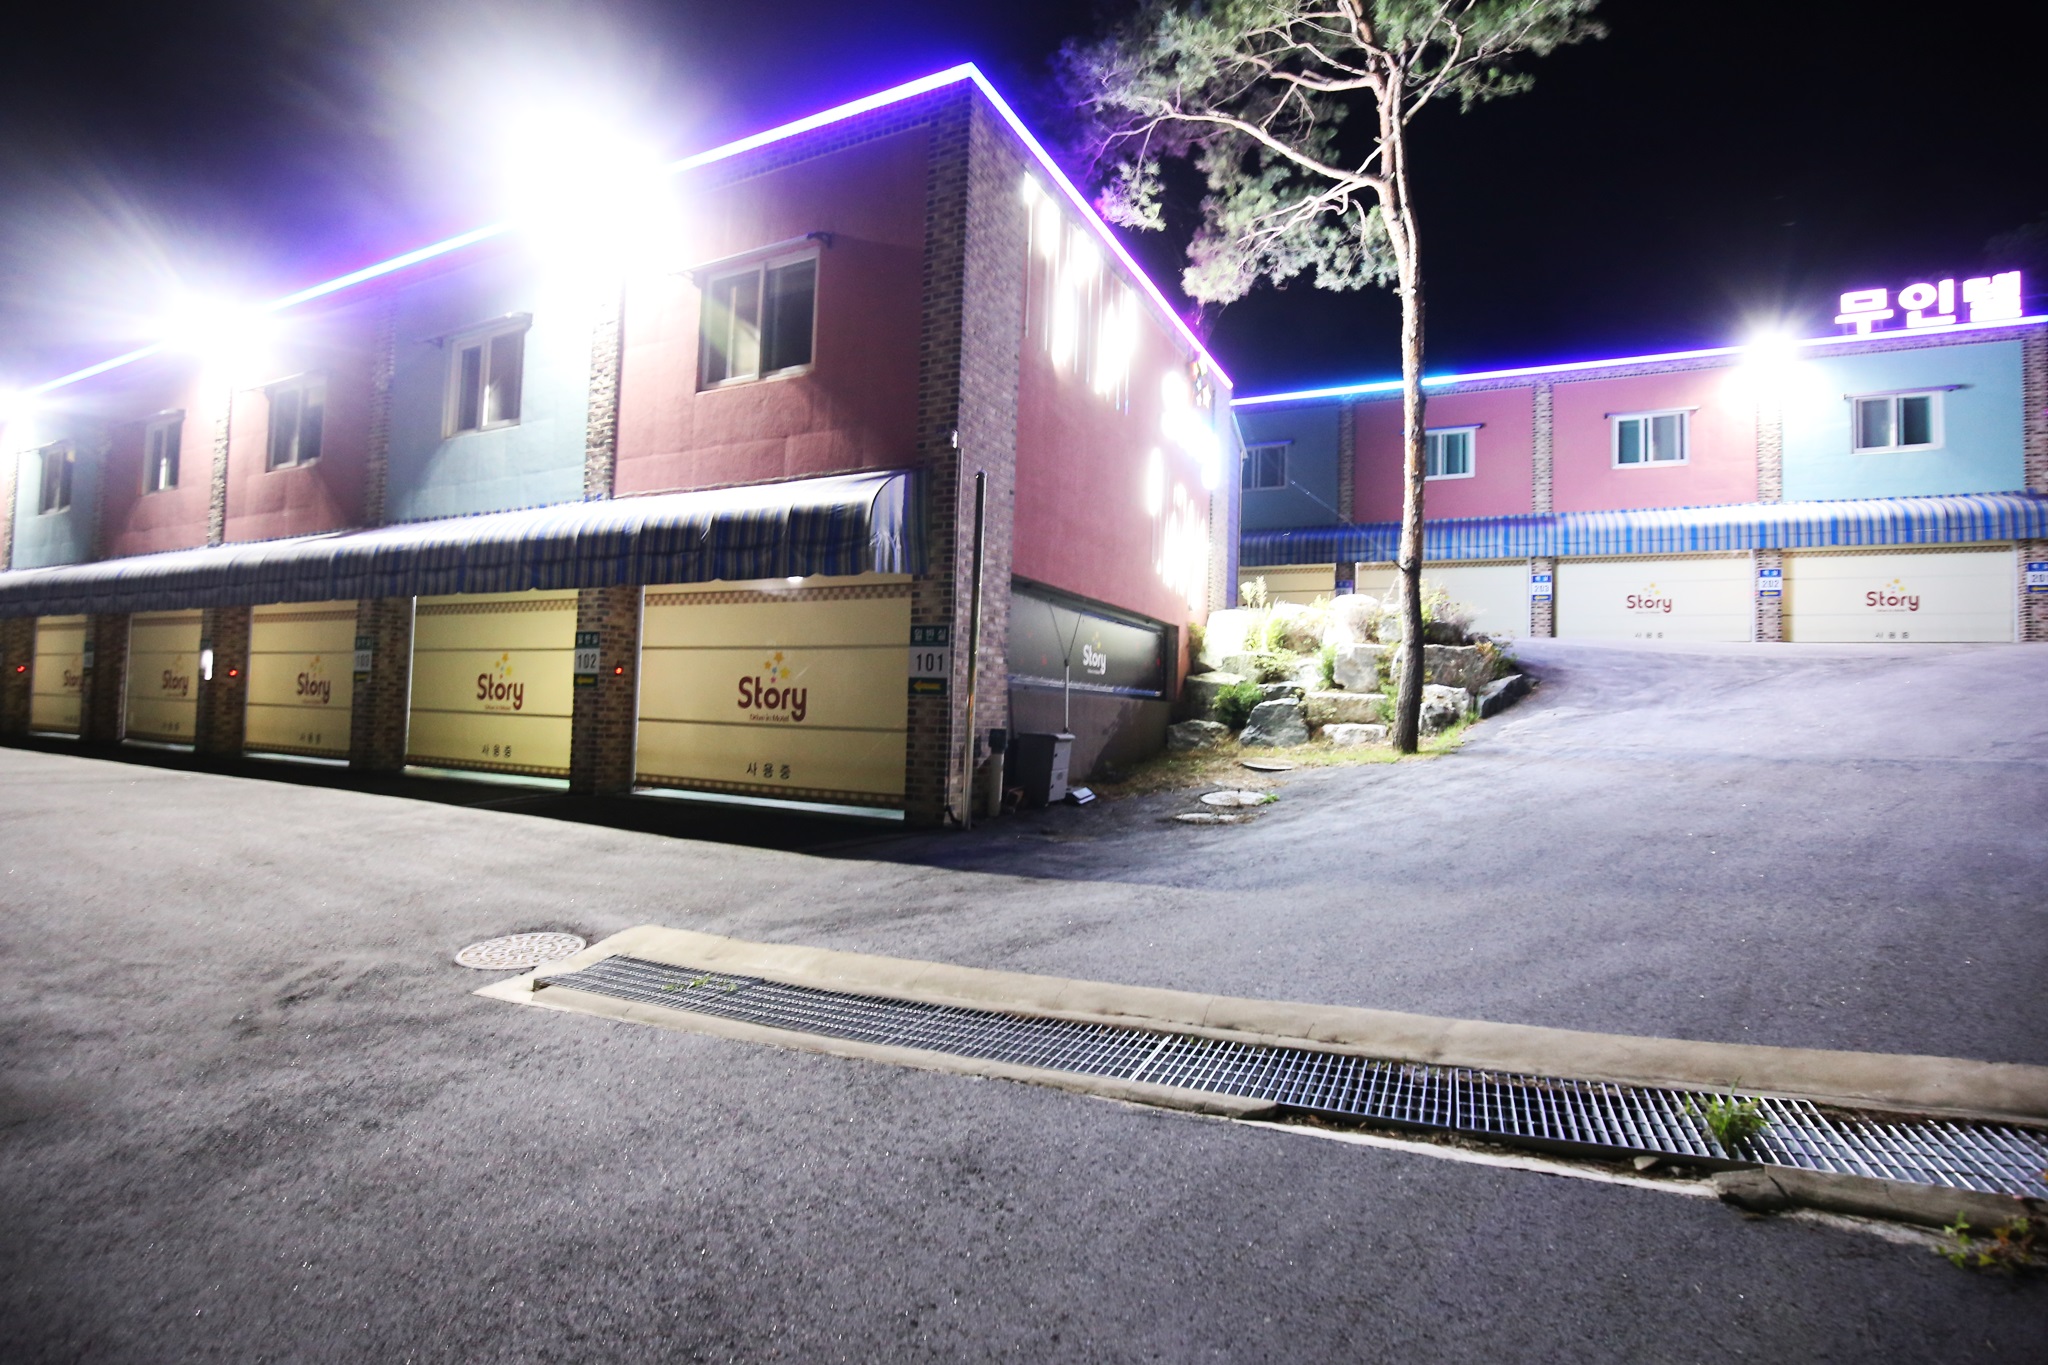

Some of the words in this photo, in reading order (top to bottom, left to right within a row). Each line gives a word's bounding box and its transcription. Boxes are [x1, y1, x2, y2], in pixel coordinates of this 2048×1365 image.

[1834, 270, 2023, 335] 무인텔
[1762, 579, 1780, 590] 202
[2032, 573, 2048, 583] 20
[1626, 594, 1673, 614] Story
[1866, 591, 1920, 612] Story
[577, 653, 597, 669] 102
[916, 652, 943, 672] 101
[1082, 644, 1107, 676] Story
[162, 669, 189, 697] Story
[296, 672, 331, 705] Story
[476, 673, 524, 711] Story
[737, 676, 807, 722] Story
